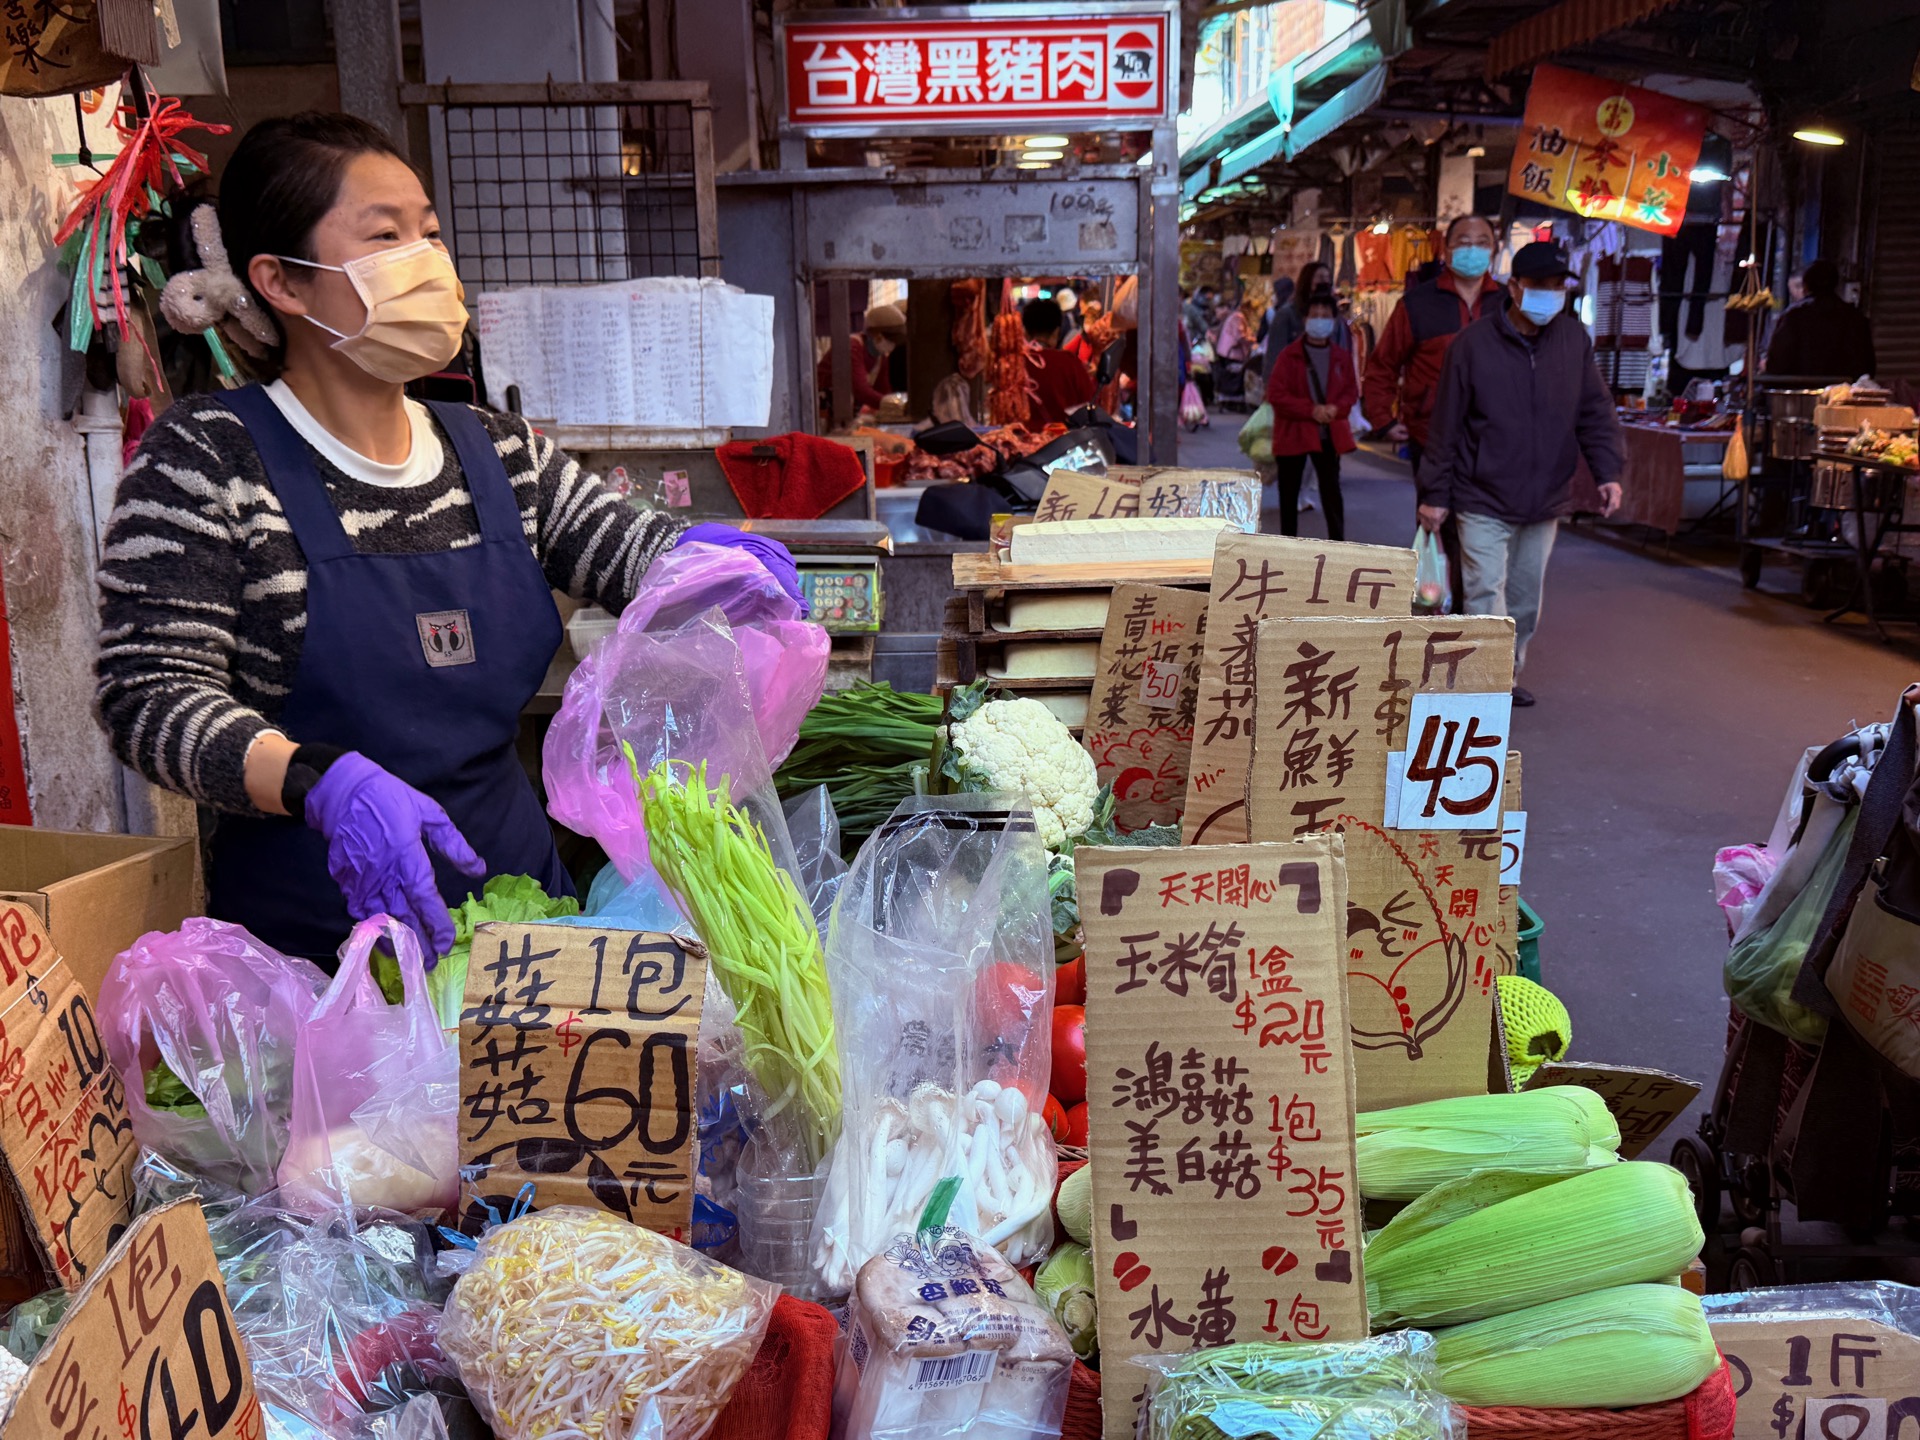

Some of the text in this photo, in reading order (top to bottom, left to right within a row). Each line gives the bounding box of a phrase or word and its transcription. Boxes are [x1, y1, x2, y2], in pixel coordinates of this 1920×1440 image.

[803, 38, 1103, 104] 台灣黑豬肉
[1520, 125, 1568, 200] 油飯
[1636, 152, 1681, 226] 小菜
[1406, 714, 1502, 817] 45
[1158, 863, 1278, 909] 天天開心
[1115, 921, 1246, 1003] 玉米筍
[1111, 1040, 1254, 1127] 鴻喜菇
[1299, 1043, 1333, 1075] 元
[623, 1160, 688, 1207] 元
[1123, 1118, 1262, 1200] 美白菇
[1315, 1219, 1346, 1250] 元
[917, 1277, 1009, 1302] 杏鮑菇
